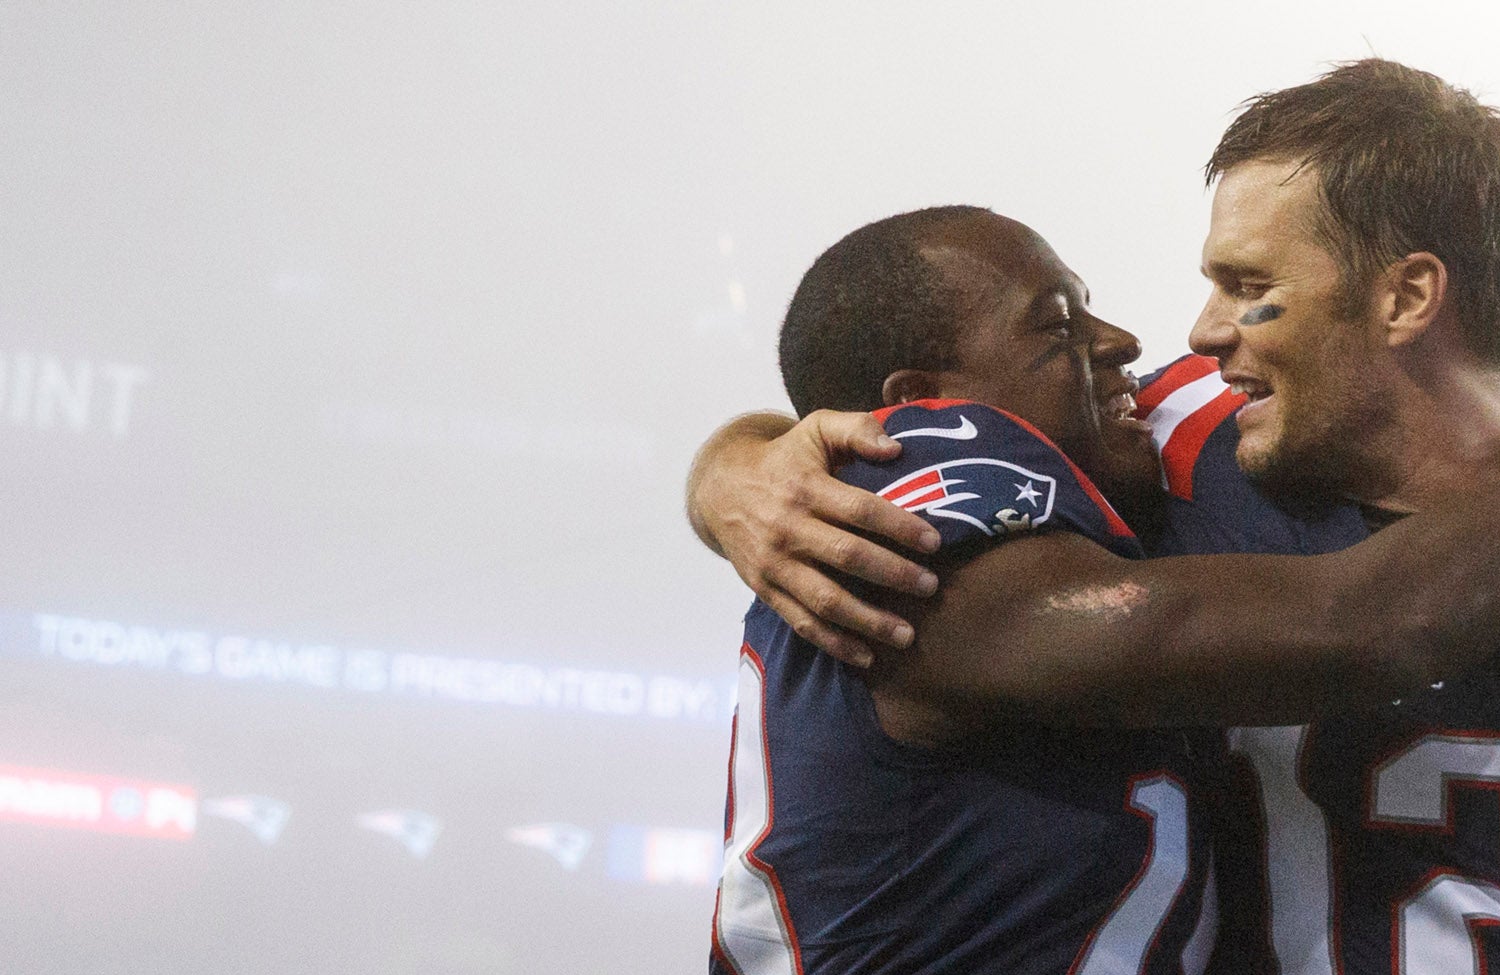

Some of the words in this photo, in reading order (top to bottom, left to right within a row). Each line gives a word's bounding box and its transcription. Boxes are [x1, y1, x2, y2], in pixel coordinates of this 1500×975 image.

[0, 352, 149, 437] INT
[36, 612, 211, 675] TODAY'S
[215, 636, 340, 688] GAME
